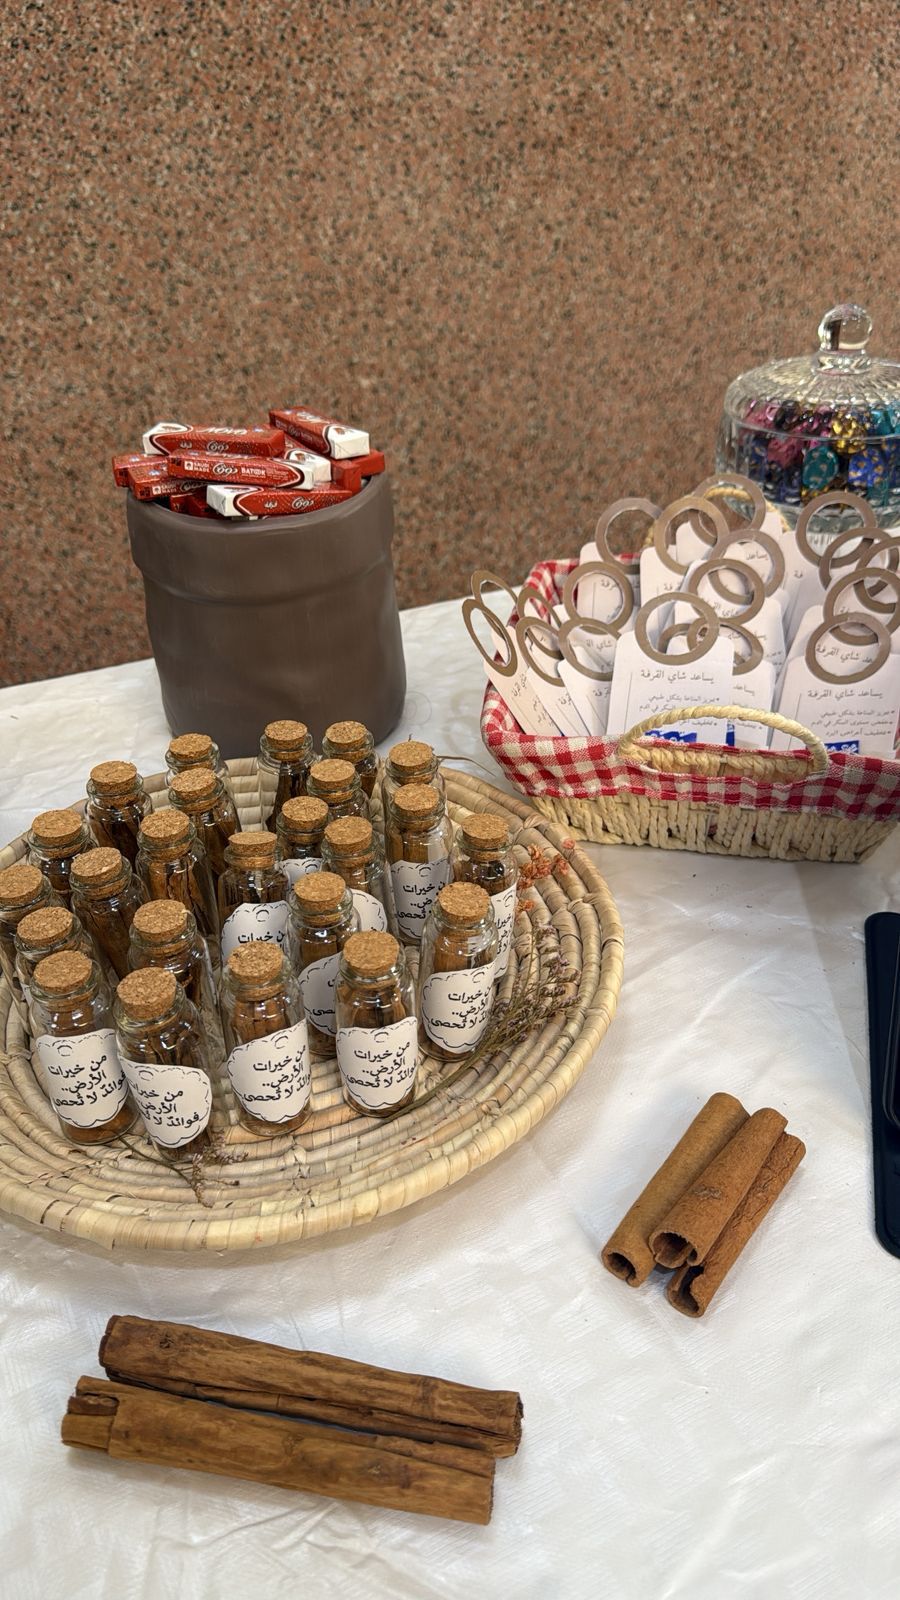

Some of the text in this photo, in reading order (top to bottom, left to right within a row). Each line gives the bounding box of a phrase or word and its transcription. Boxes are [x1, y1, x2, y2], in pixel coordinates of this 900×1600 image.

[640, 669, 715, 685] يساعد شاي القرفة
[807, 688, 884, 701] يساعد شاي القرفة
[402, 883, 436, 896] خيرات
[447, 989, 483, 1004] خيرات
[353, 1049, 393, 1063] خيرات
[47, 1054, 107, 1079] من خيرات
[252, 1055, 293, 1073] خيرات
[86, 1090, 98, 1105] لا
[164, 1089, 184, 1102] من
